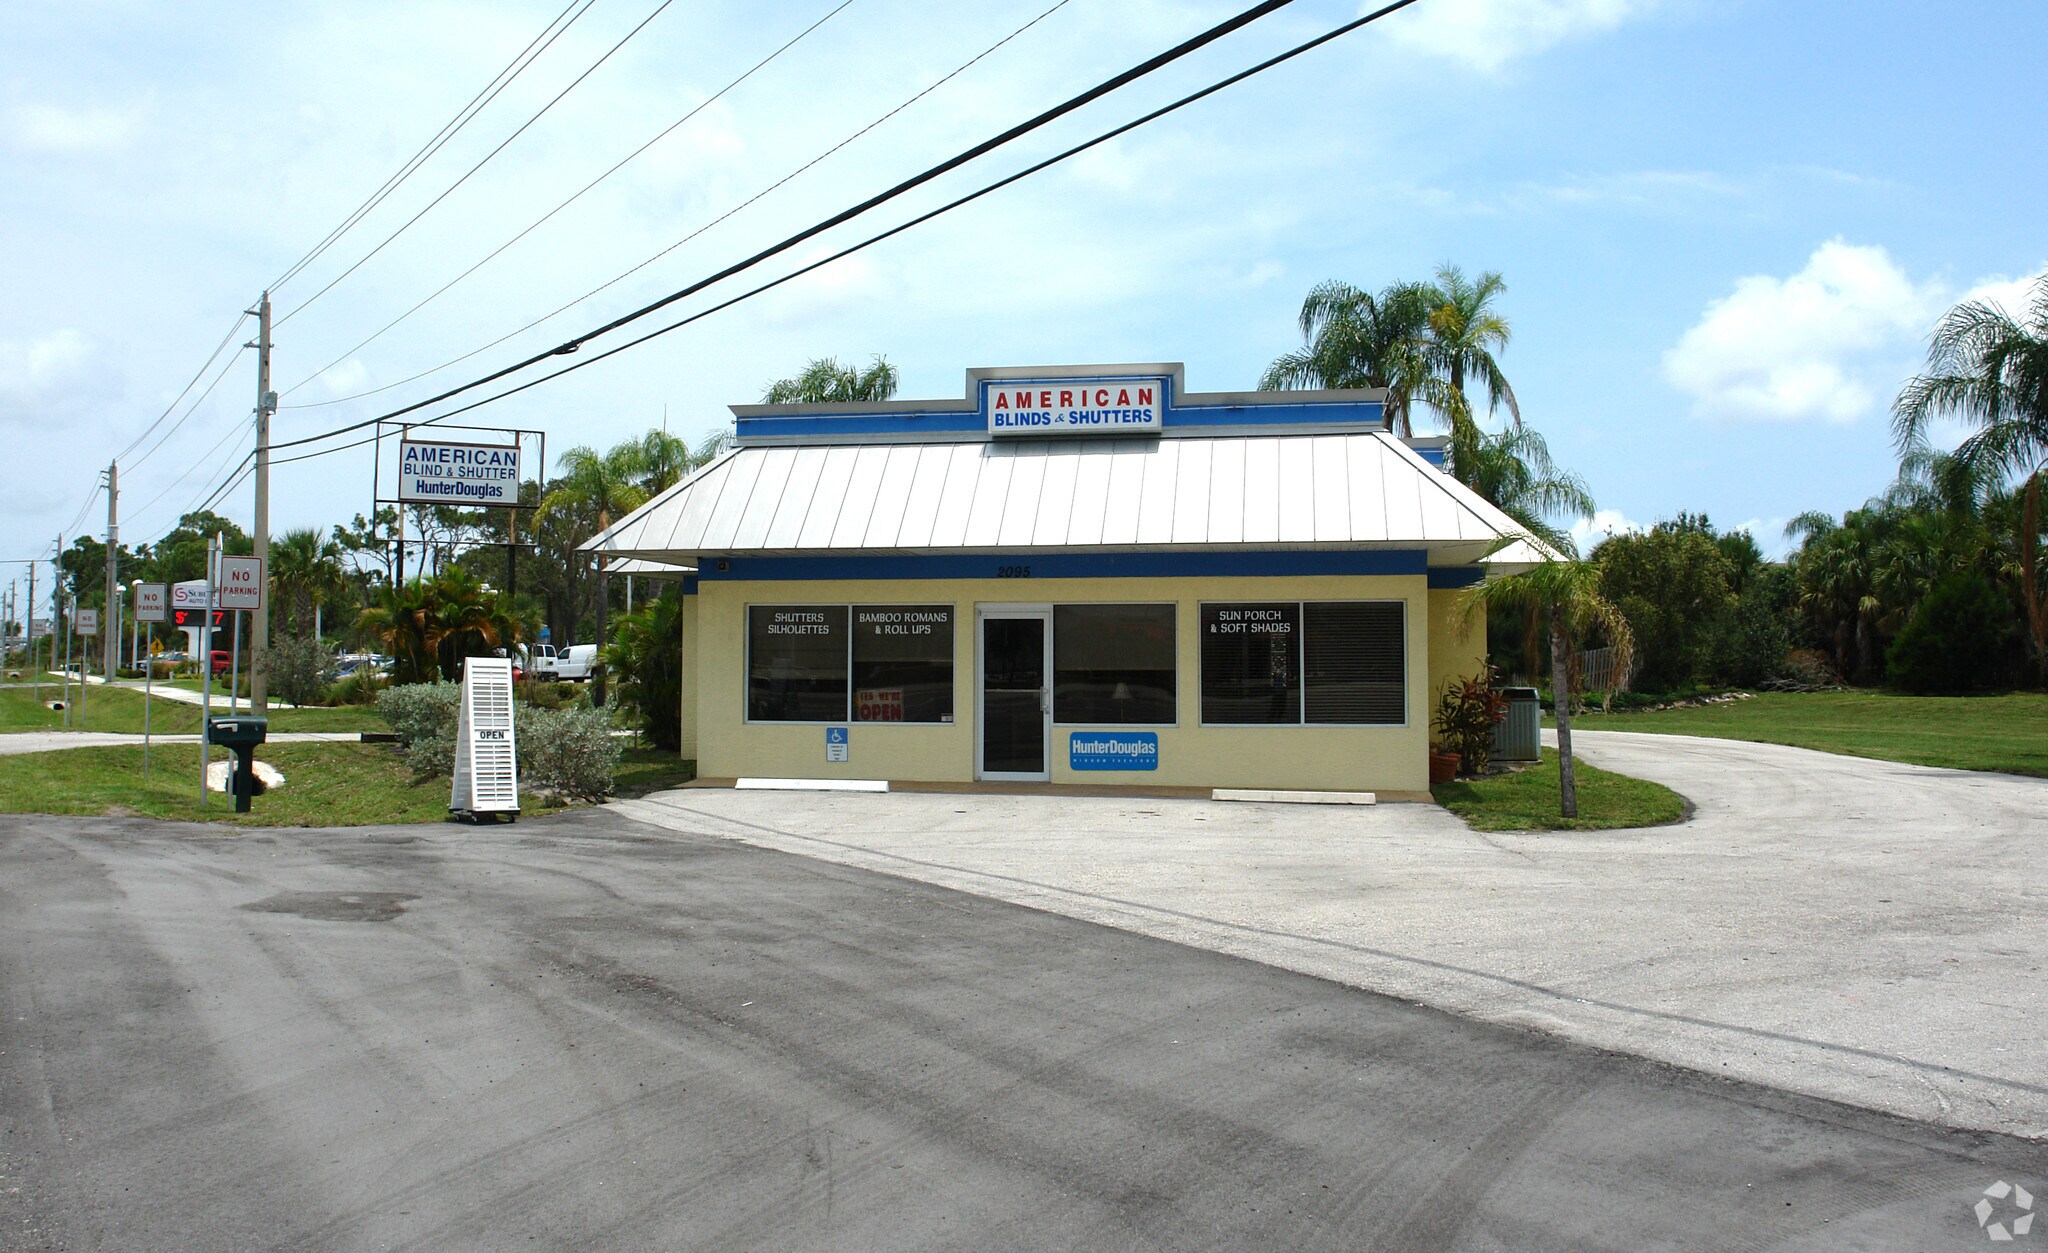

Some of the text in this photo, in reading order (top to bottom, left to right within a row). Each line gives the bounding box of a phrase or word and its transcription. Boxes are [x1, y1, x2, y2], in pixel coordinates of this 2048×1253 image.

[995, 388, 1153, 409] AMERICAN
[994, 409, 1152, 427] BLINDS & SHUTTERS
[405, 447, 517, 466] AMERICAN
[404, 463, 516, 479] BLIND & SHUTTER
[416, 479, 503, 499] HunterDouglas
[232, 571, 250, 581] NO
[997, 566, 1031, 578] 2095
[223, 586, 258, 595] PARKING
[144, 593, 158, 601] NO
[775, 613, 824, 622] SHUTTERS
[859, 612, 948, 622] BAMBOO ROMANS
[1219, 610, 1282, 620] SUN PORCH
[768, 625, 829, 634] SILHOUETTES
[875, 625, 931, 634] & ROLL UPS
[1210, 622, 1291, 633] & SOFT SHADES
[860, 703, 902, 721] OPEN
[480, 731, 505, 740] OPEN
[1072, 739, 1156, 757] HunterDouglas
